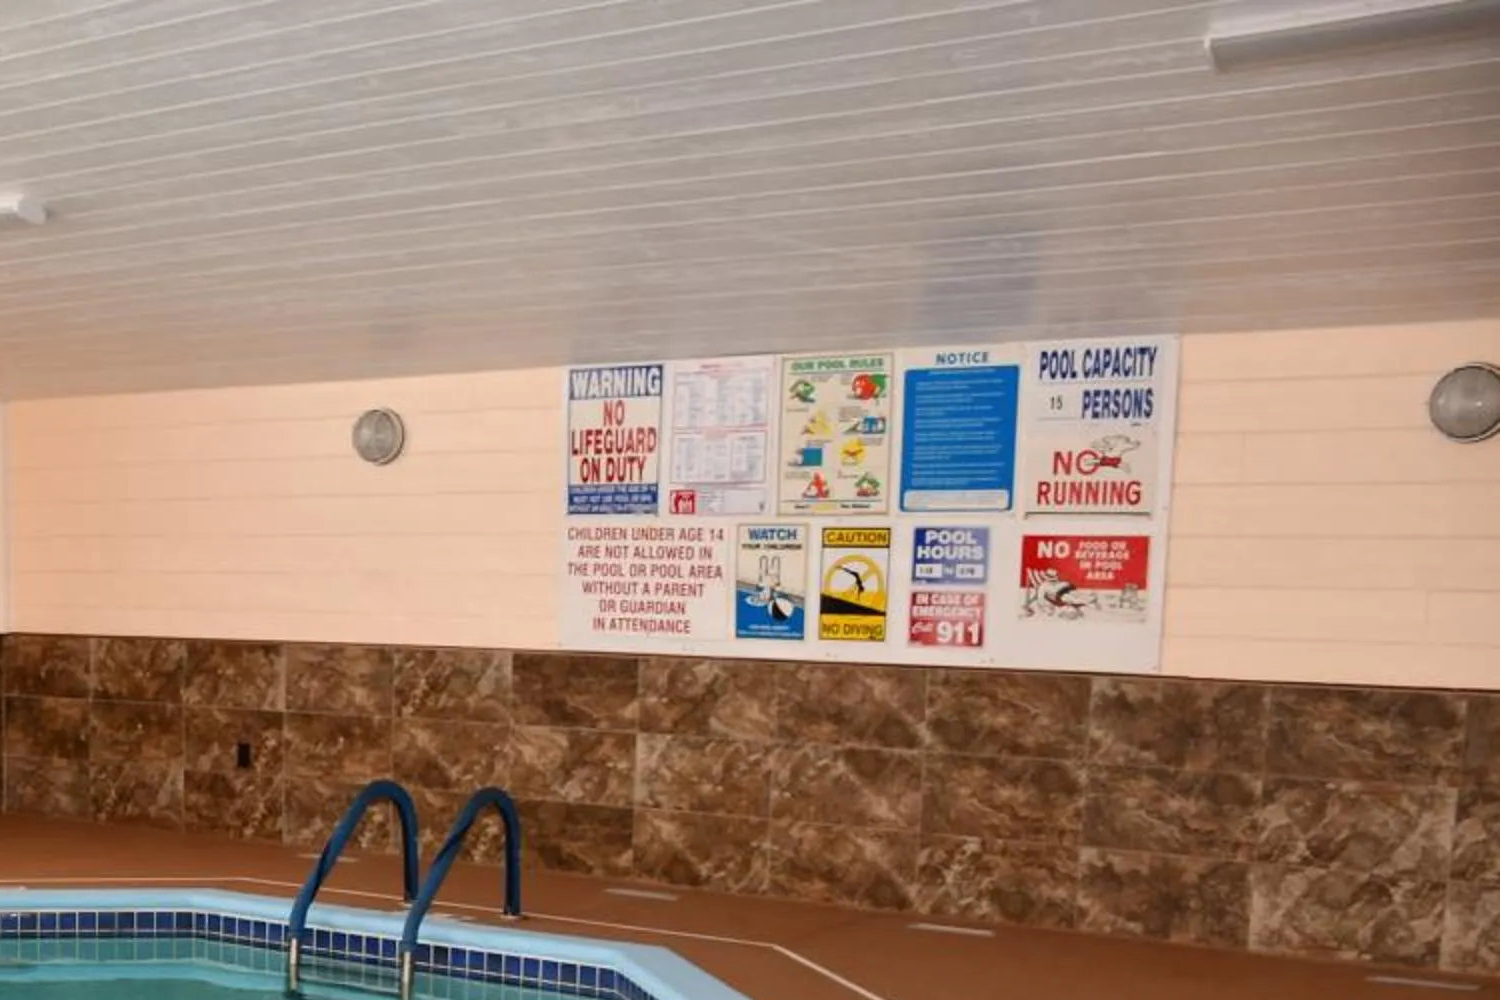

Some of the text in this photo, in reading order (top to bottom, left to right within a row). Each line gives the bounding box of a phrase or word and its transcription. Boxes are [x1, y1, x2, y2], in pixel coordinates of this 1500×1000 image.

[792, 358, 884, 371] OUR POOL RULES
[936, 352, 989, 364] NOTICE
[1039, 346, 1158, 380] POOL CAPACITY
[571, 368, 661, 399] WARNING
[1050, 388, 1154, 420] 15 PERSONS
[603, 400, 626, 426] NO
[572, 427, 657, 456] LIFEGUARD
[580, 458, 600, 483] ON
[606, 456, 647, 482] DUTY
[1052, 449, 1100, 476] NO
[1036, 481, 1142, 506] RUNNING
[567, 526, 724, 542] CHILDREN UNDER AGE 14
[748, 528, 798, 541] WATCH
[826, 531, 888, 544] CAUTION
[925, 530, 976, 545] POOL
[578, 545, 714, 560] ARE NOT ALLOWED IN
[916, 546, 984, 560] HOURS
[1037, 540, 1127, 558] NO FOOD OR
[1076, 550, 1130, 560] BEVERAGE
[568, 562, 724, 579] THE POOL OR POOL AREA
[1086, 572, 1116, 580] AREA
[582, 581, 705, 597] WITHOUT A PARENT
[598, 599, 686, 614] OR GUARDIAN
[916, 592, 980, 605] IN CASE OF
[912, 606, 982, 619] EMERGENCY
[592, 617, 692, 634] IN ATTENDANCE
[822, 623, 883, 636] NO DIVING
[936, 620, 980, 644] 911
